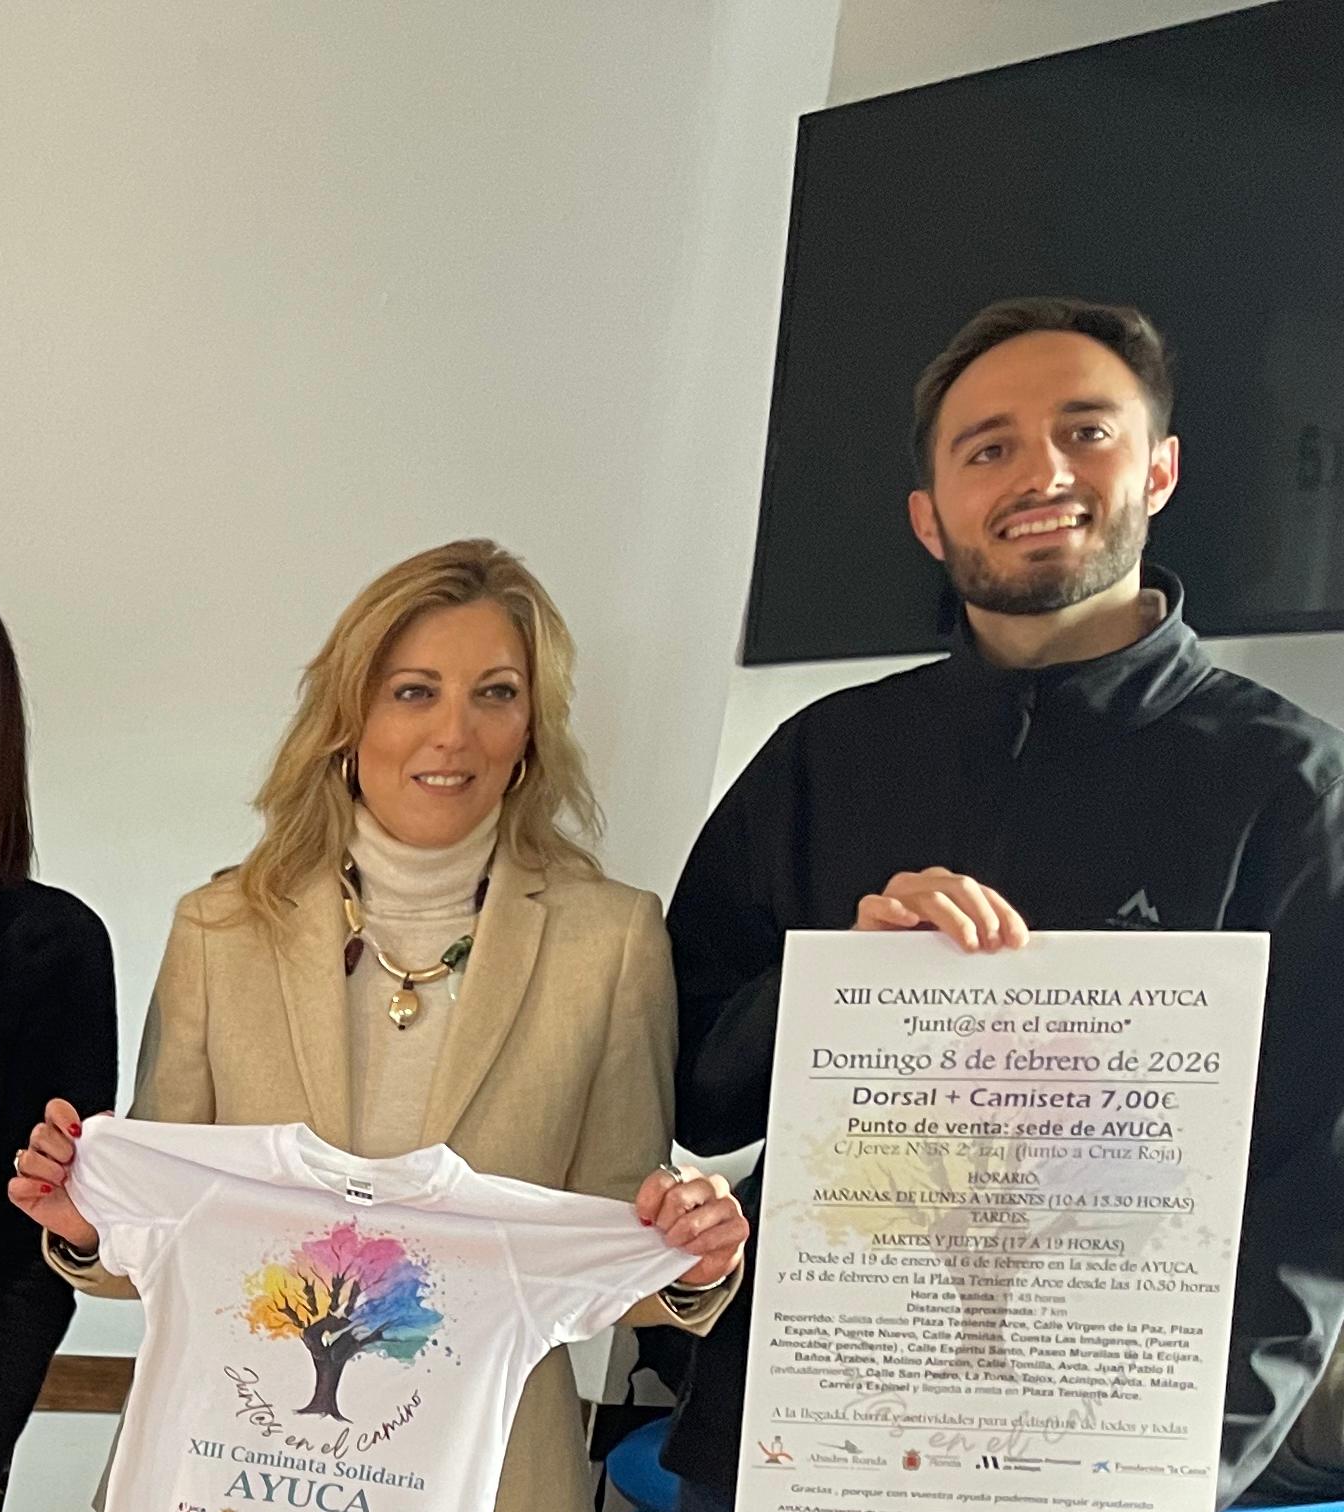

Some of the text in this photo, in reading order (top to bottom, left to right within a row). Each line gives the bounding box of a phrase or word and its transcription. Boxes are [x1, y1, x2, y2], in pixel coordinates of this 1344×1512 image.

[834, 987, 1209, 1007] XIII CAMINATA SOLIDARIA AYUCA
[990, 1020, 1016, 1033] en
[1021, 1016, 1039, 1033] el
[811, 1048, 1221, 1076] Domingo 8 de febrero de 2026
[852, 1086, 1179, 1113] Dorsal + Camiseta 7,00€
[847, 1117, 1173, 1138] Punto de venta: sede de AYUCA
[777, 1271, 786, 1284] y
[789, 1269, 802, 1280] el
[805, 1269, 815, 1281] 8
[818, 1270, 835, 1281] de
[838, 1270, 890, 1284] febrero
[892, 1274, 909, 1284] en
[913, 1272, 926, 1284] la
[929, 1273, 965, 1286] Plaza
[969, 1274, 1029, 1288] Teniente
[1030, 1276, 1064, 1288] Arce
[1066, 1277, 1106, 1289] desde
[1110, 1278, 1130, 1290] las
[1180, 1280, 1221, 1293] horas
[1065, 1321, 1105, 1334] Virgen
[1107, 1322, 1123, 1332] de
[1170, 1324, 1203, 1335] Plaza
[188, 1438, 426, 1492] XIII Caminata Solidaria
